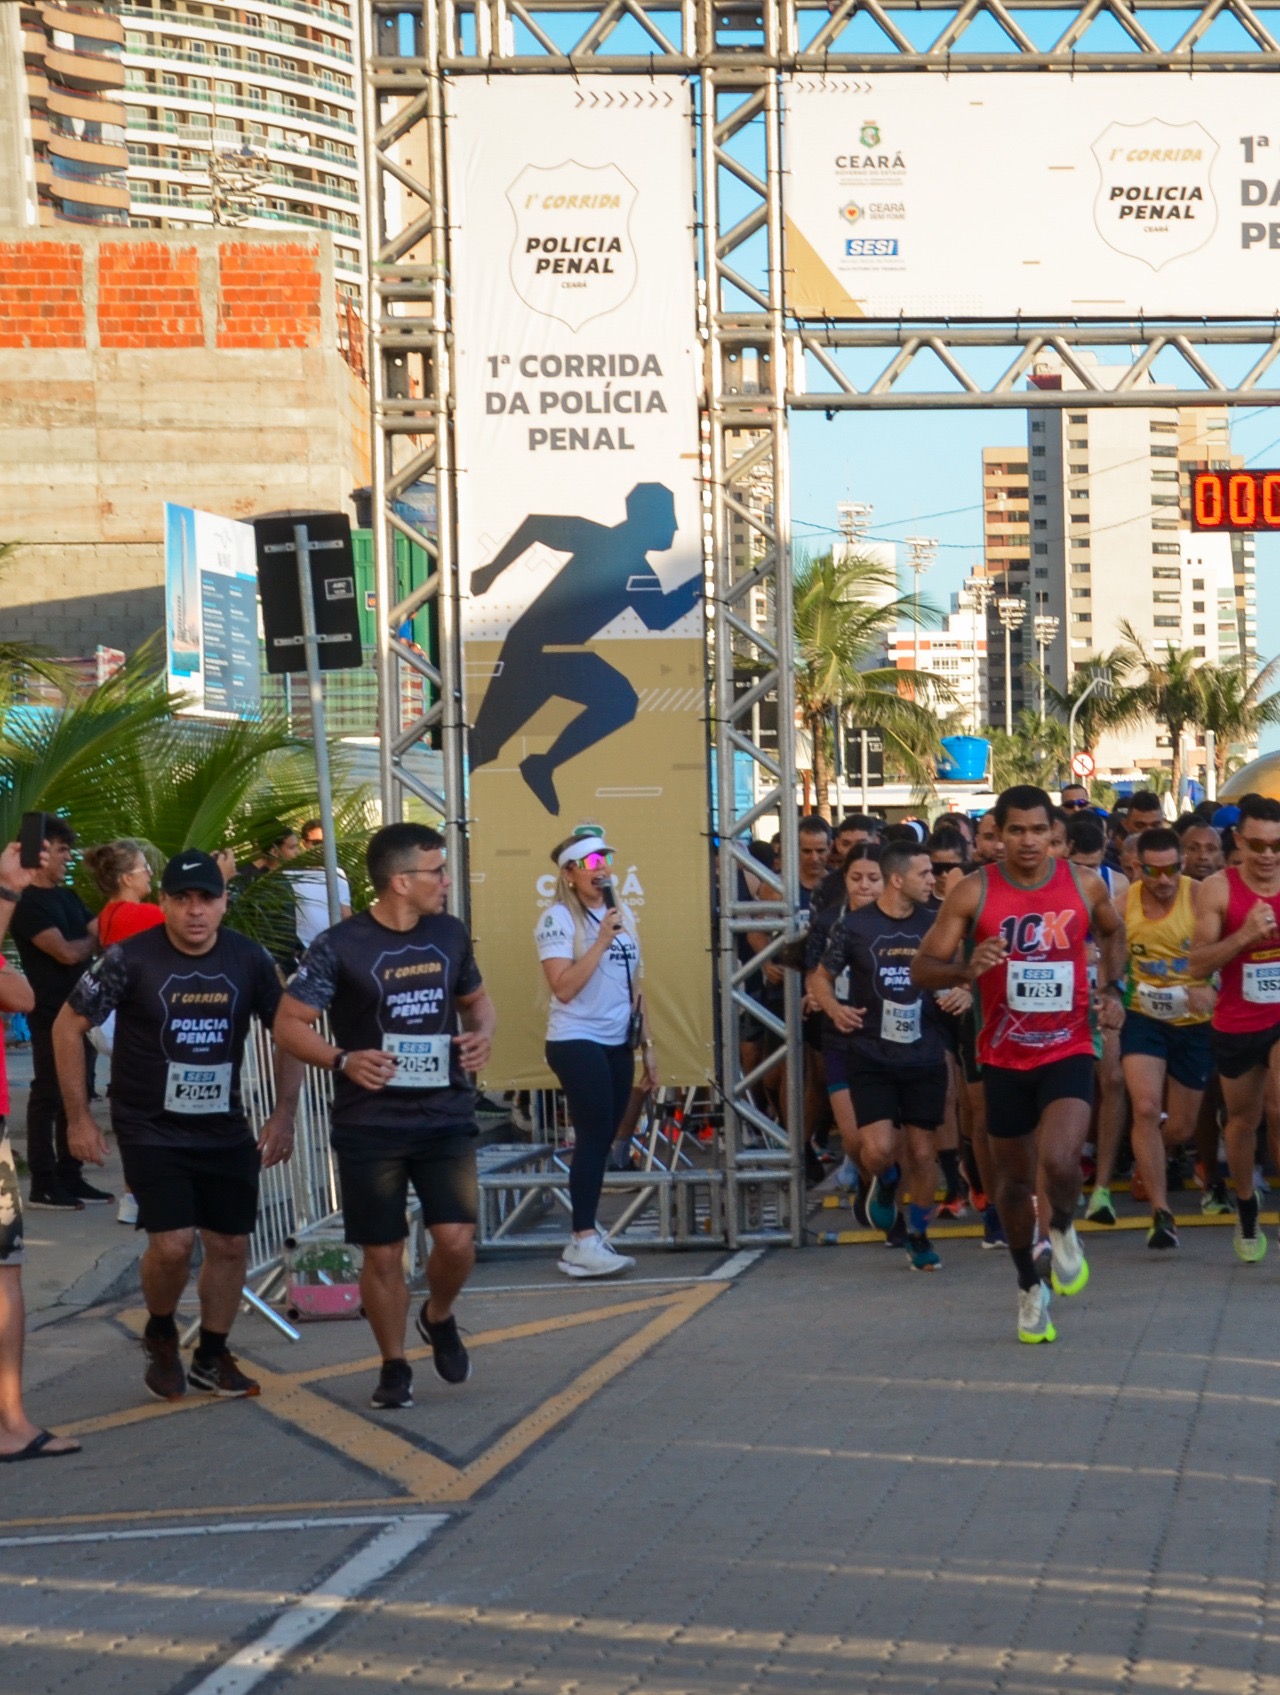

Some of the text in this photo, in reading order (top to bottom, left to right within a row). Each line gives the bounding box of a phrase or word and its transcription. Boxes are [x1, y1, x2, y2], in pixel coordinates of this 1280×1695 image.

[1126, 148, 1203, 162] CORRIDA
[1239, 136, 1270, 164] 1ª
[835, 151, 906, 168] CEARÁ
[1109, 186, 1203, 201] POLICIA
[542, 194, 621, 209] CORRIDA
[869, 201, 906, 213] CEARÁ
[1118, 205, 1195, 220] PENAL
[525, 236, 622, 253] POLICIA
[848, 239, 896, 256] SESI
[535, 258, 614, 274] PENAL
[487, 354, 663, 378] 1ª CORRIDA
[485, 381, 668, 415] DA POLÍCIA
[528, 427, 635, 451] PENAL
[1000, 909, 1076, 954] 10K
[395, 962, 442, 979] CORRIDA
[880, 967, 911, 976] POLIC
[1025, 969, 1053, 979] SESI
[884, 976, 911, 986] PENA
[386, 988, 443, 1006] POLICIA
[1023, 983, 1057, 997] 1783
[181, 992, 229, 1004] CORRIDA
[391, 1002, 439, 1018] PENAL
[170, 1018, 229, 1031] POLICIA
[176, 1031, 225, 1044] PENAL
[400, 1042, 431, 1053] SESI
[397, 1056, 437, 1072] 2054
[185, 1072, 215, 1082] SESI
[179, 1084, 220, 1100] 2044
